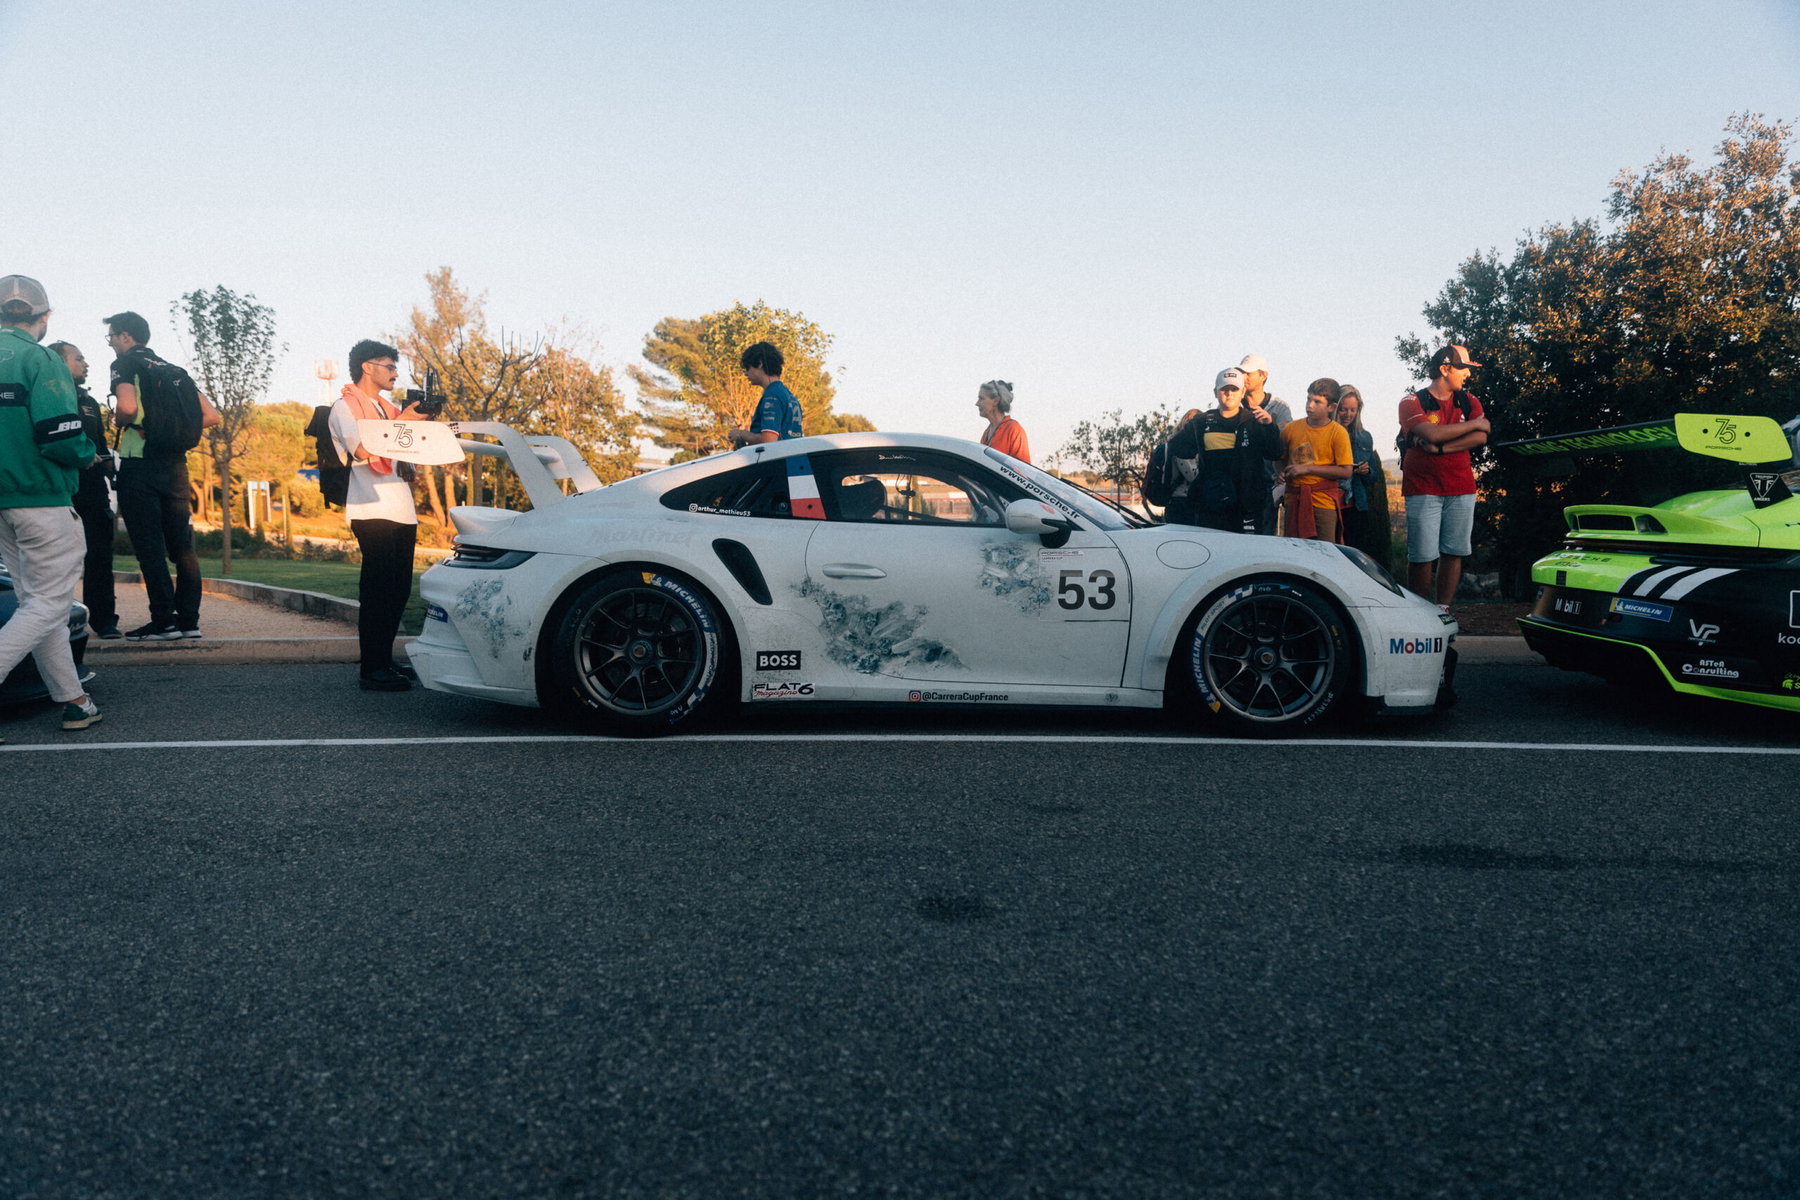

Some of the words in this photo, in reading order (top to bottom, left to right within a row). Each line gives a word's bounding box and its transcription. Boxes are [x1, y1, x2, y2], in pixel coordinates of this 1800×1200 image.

[393, 423, 414, 449] 75
[1714, 418, 1737, 445] 75
[1000, 466, 1081, 519] www.porsche.fr
[1058, 569, 1116, 610] 53
[664, 581, 711, 628] MICHELIN
[1555, 598, 1574, 613] Mbil
[1624, 603, 1663, 615] MICHELIN
[1389, 638, 1432, 654] Mobil
[759, 654, 798, 667] BOSS
[1192, 637, 1209, 694] MICHELIN
[922, 691, 1009, 702] @CarreraCupFrance
